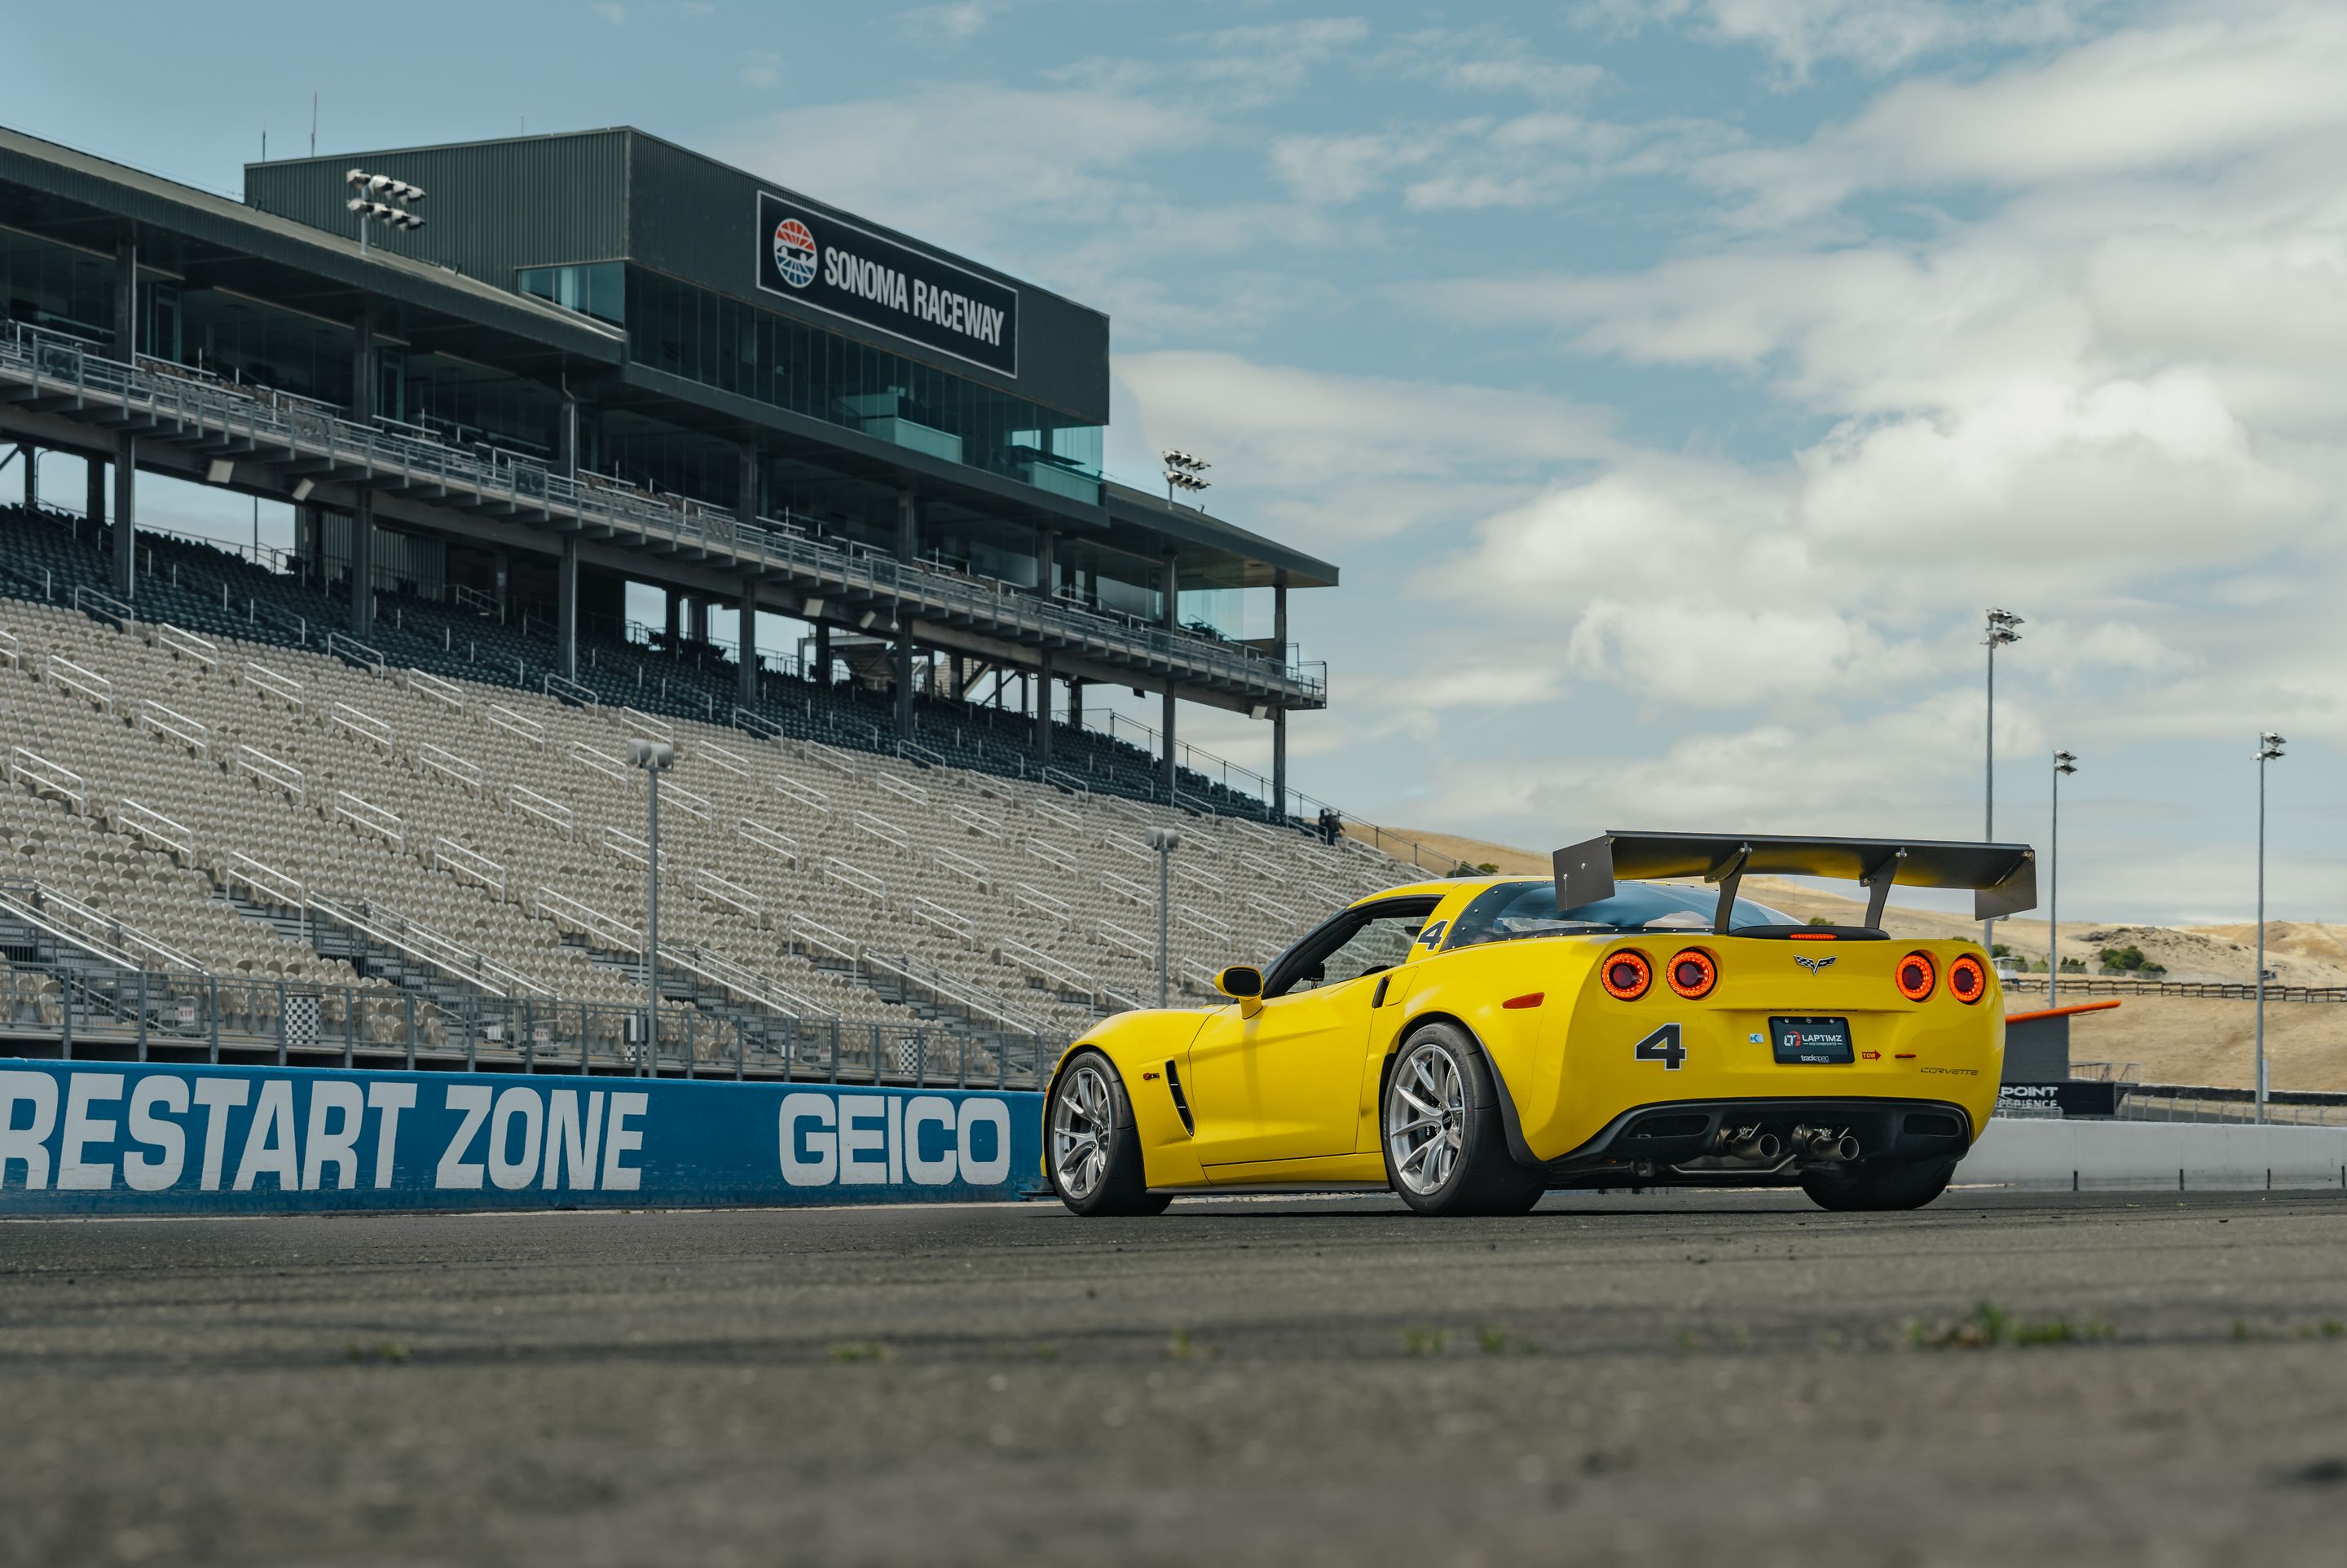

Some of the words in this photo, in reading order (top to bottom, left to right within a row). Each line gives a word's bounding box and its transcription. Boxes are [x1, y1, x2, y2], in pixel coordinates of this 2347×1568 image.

[824, 246, 909, 313] SONOMA
[913, 279, 1004, 346] RACEWAY
[1416, 919, 1450, 951] 4
[1635, 1022, 1687, 1071] 4
[1802, 1034, 1843, 1042] LAPTIMZ
[1920, 1067, 1979, 1076] CORVETTE
[2001, 1086, 2059, 1097] POINT
[0, 1070, 417, 1191] RESTART
[435, 1085, 649, 1191] ZONE
[779, 1093, 1011, 1187] GEICO
